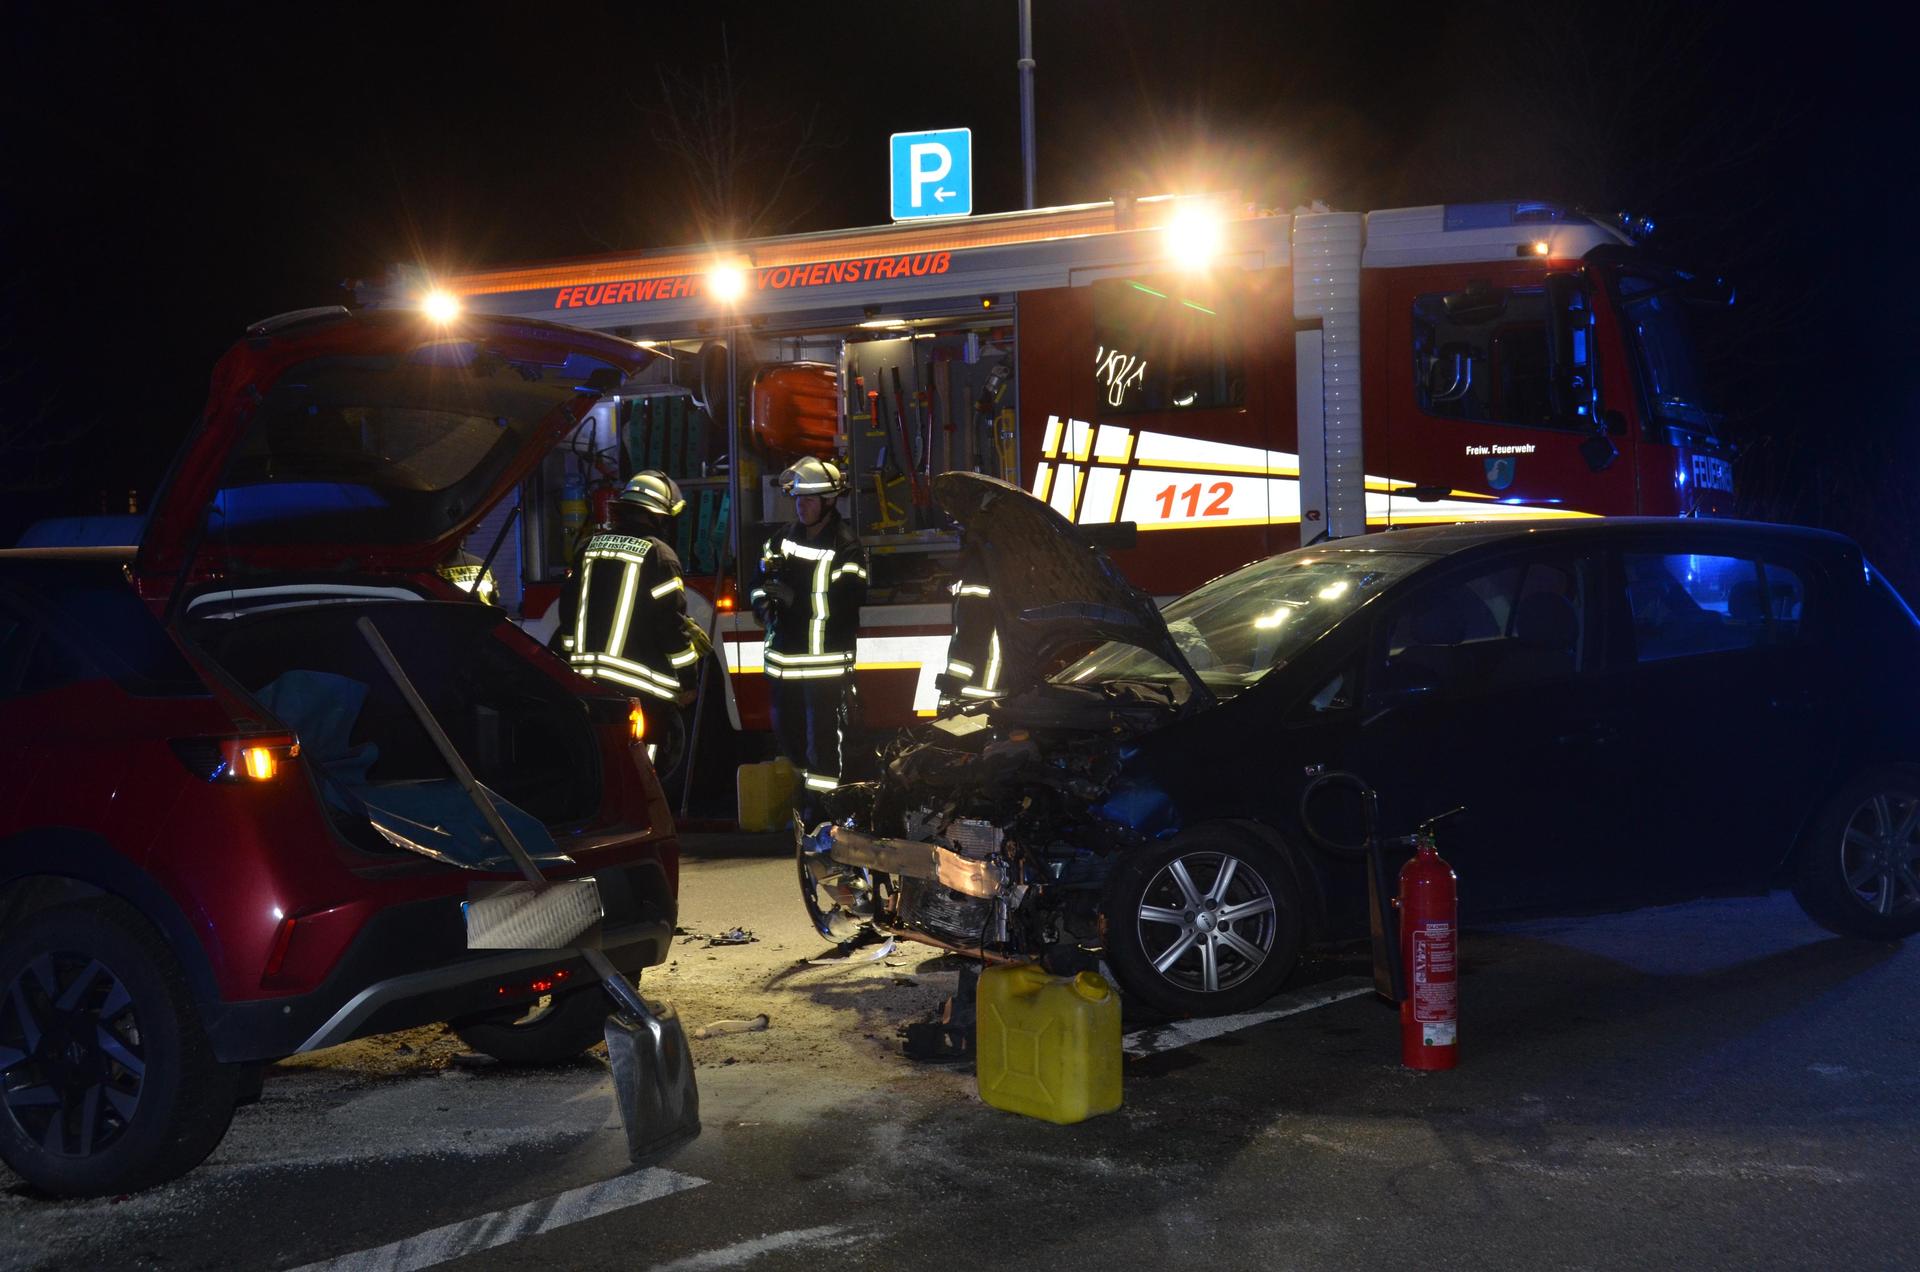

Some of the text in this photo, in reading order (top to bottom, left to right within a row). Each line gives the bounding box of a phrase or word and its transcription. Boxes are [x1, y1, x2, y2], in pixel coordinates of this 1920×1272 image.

[910, 142, 952, 208] P
[1466, 443, 1536, 456] Freiw. Feuerwehr
[1155, 482, 1234, 520] 112
